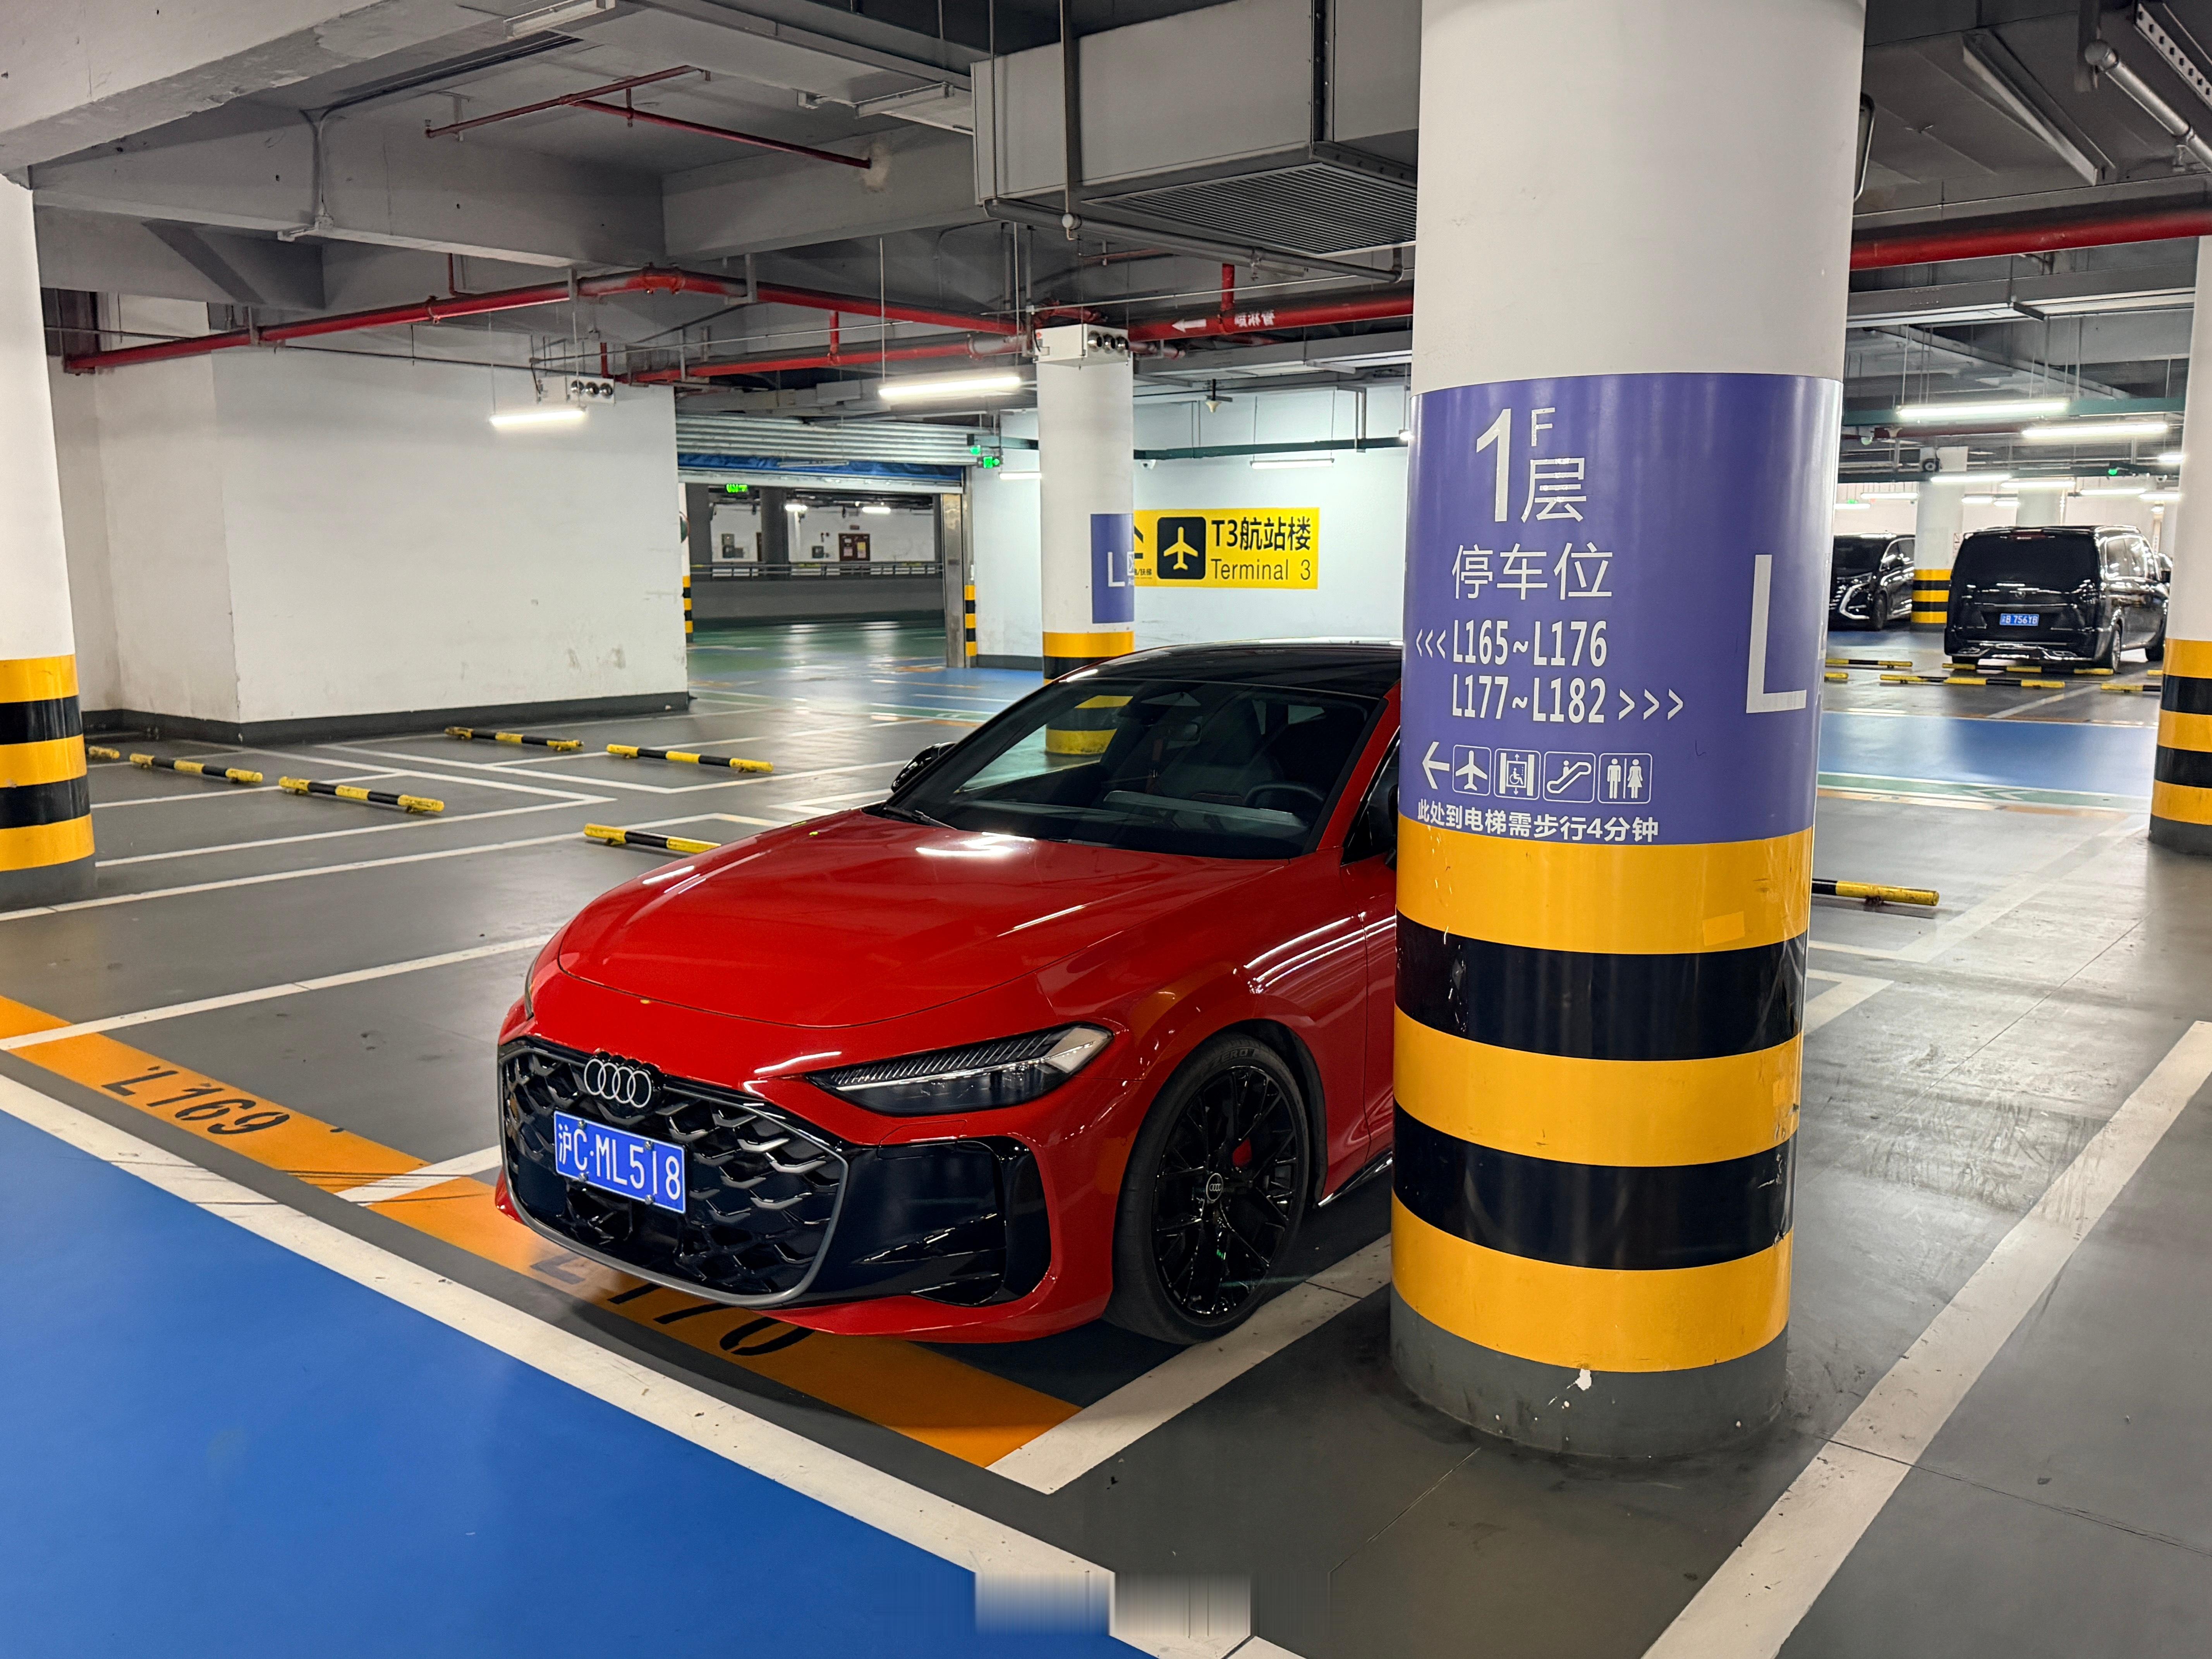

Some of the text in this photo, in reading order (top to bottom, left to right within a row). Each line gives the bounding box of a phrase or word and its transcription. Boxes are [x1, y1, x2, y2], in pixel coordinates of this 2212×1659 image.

[1211, 516, 1311, 551] T3航站楼
[1211, 559, 1310, 580] Terminal 3
[1451, 542, 1613, 600] 停车位
[1453, 620, 1607, 667] L165~L176
[1746, 554, 1807, 714] L
[1452, 674, 1606, 723] L177~L182
[1417, 798, 1659, 843] 此处到电梯需步行4分钟
[101, 1068, 290, 1135] L169
